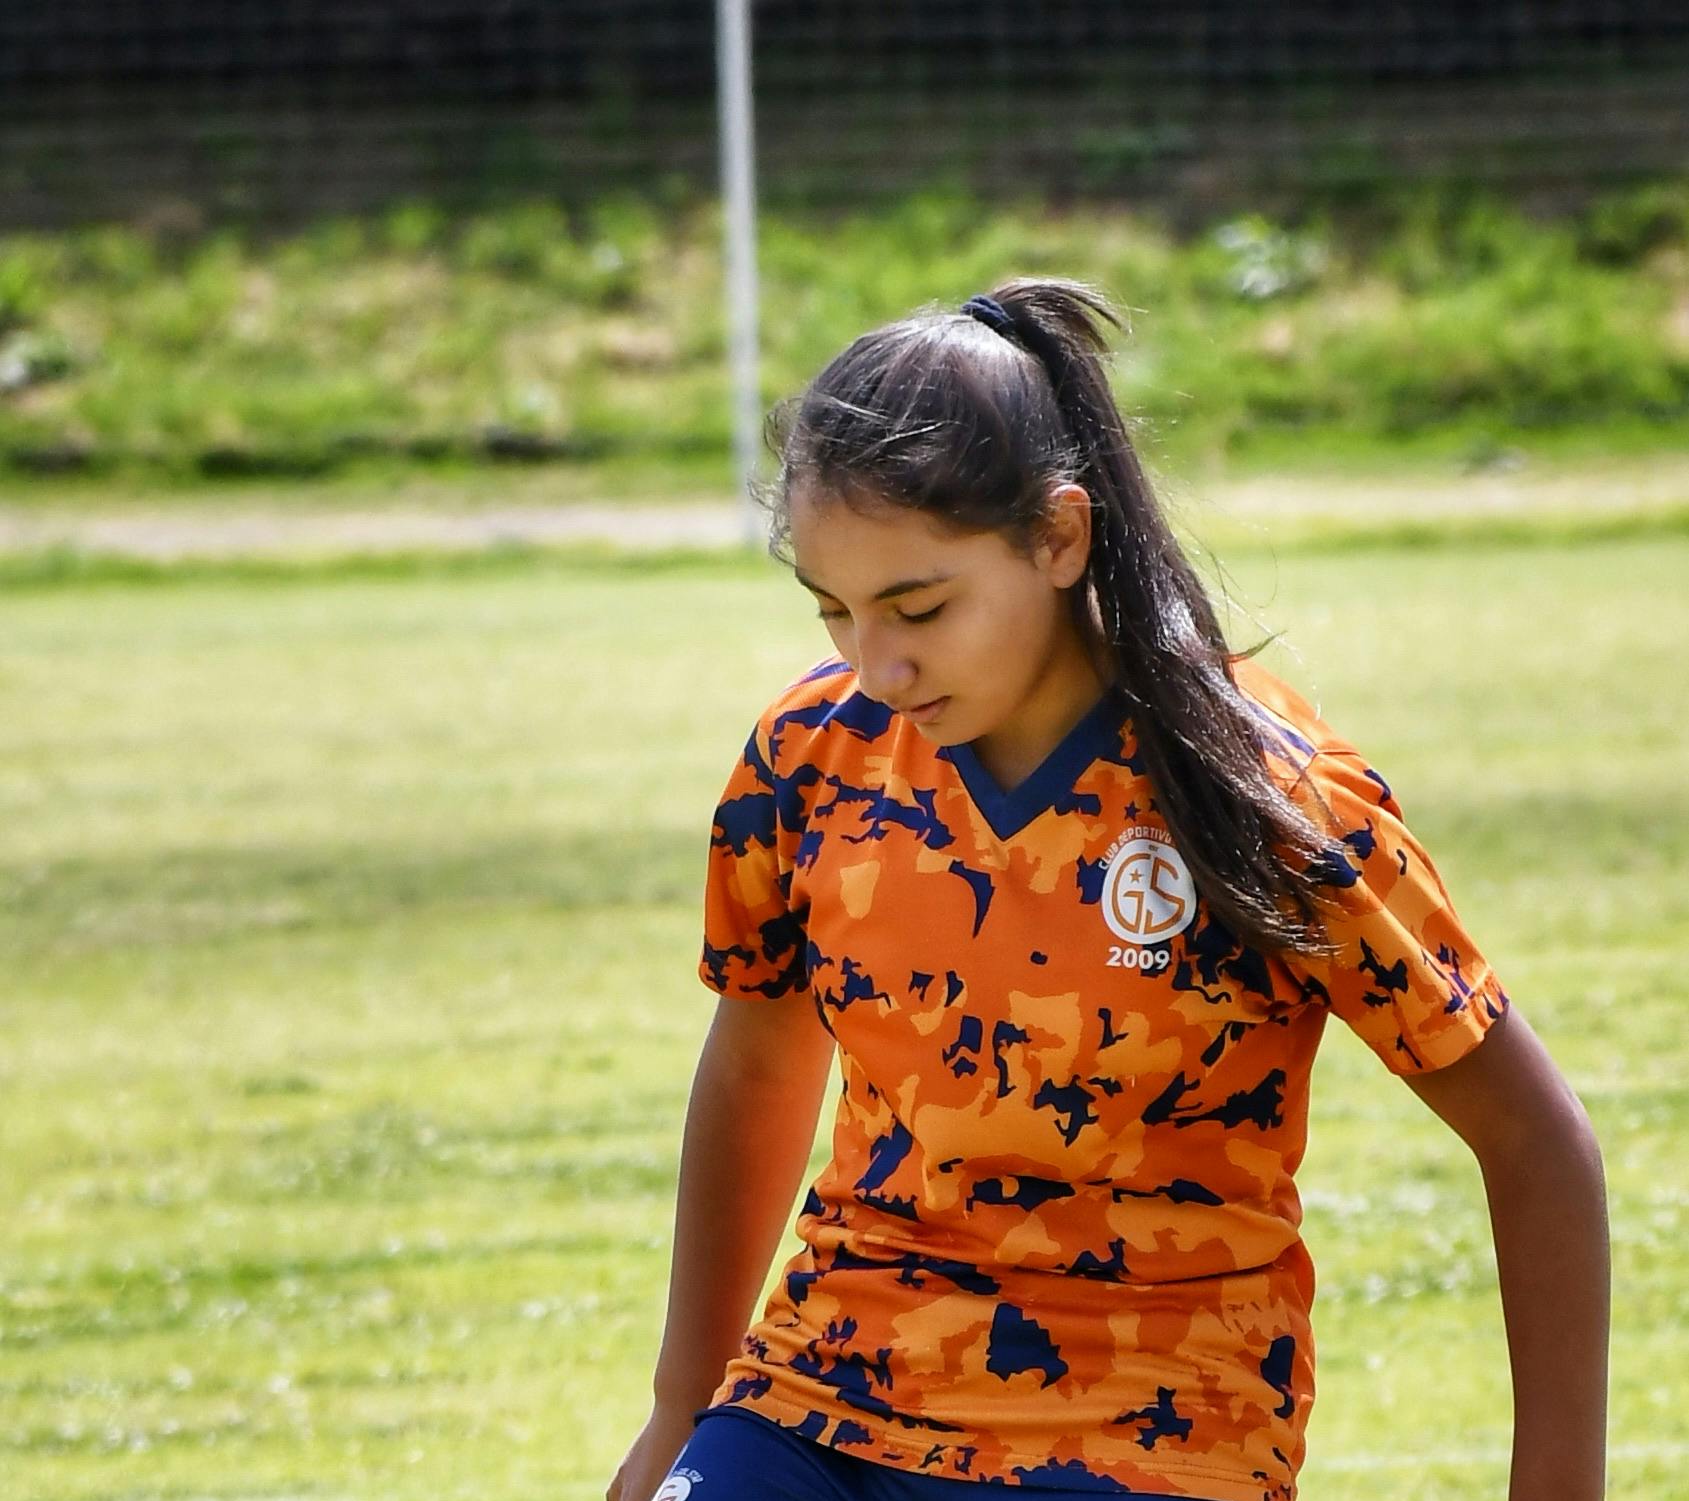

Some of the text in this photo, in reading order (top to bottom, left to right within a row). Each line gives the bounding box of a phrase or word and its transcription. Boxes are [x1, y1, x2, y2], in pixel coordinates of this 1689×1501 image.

[1098, 842, 1119, 870] CLUB
[1112, 853, 1186, 934] GS
[1105, 946, 1170, 970] 2009
